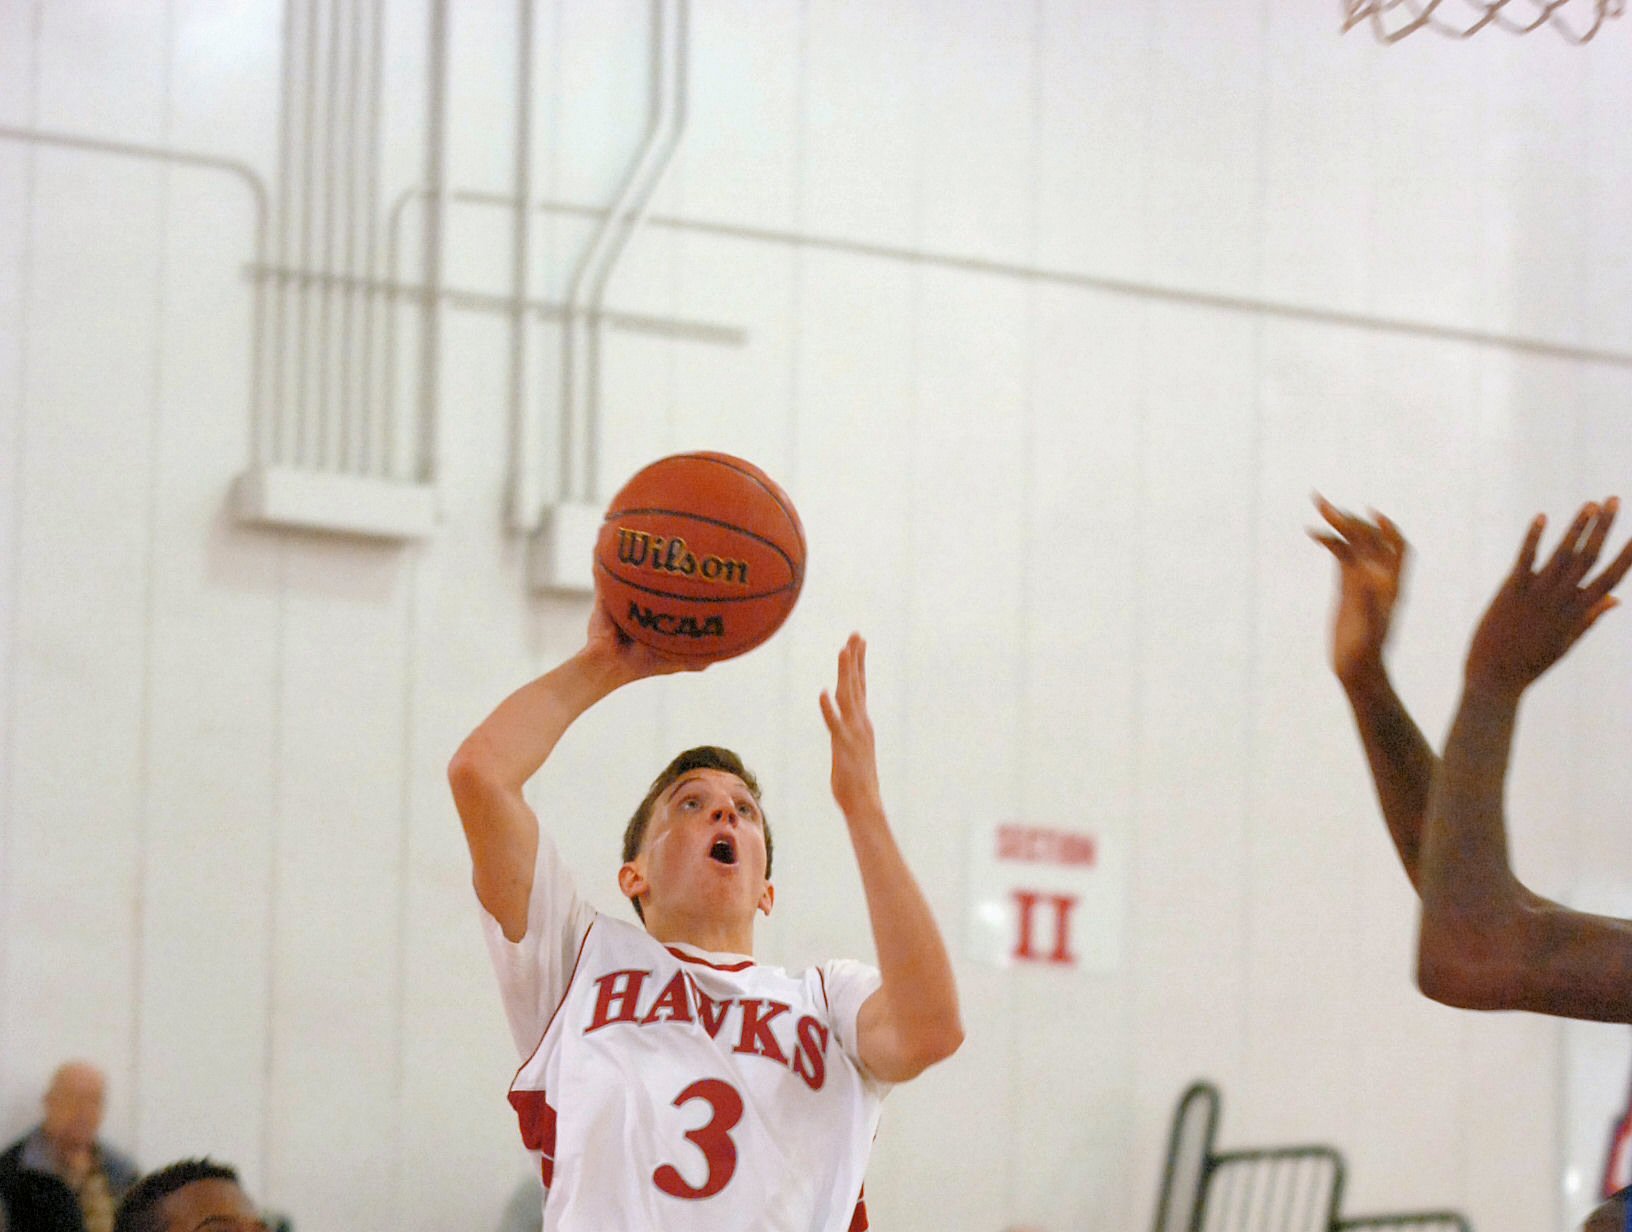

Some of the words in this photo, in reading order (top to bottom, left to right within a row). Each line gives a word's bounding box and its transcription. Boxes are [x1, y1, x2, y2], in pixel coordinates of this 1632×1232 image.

[617, 527, 748, 585] Wilson
[628, 599, 725, 639] NCAA
[1012, 890, 1078, 963] II
[653, 1078, 744, 1200] 3
